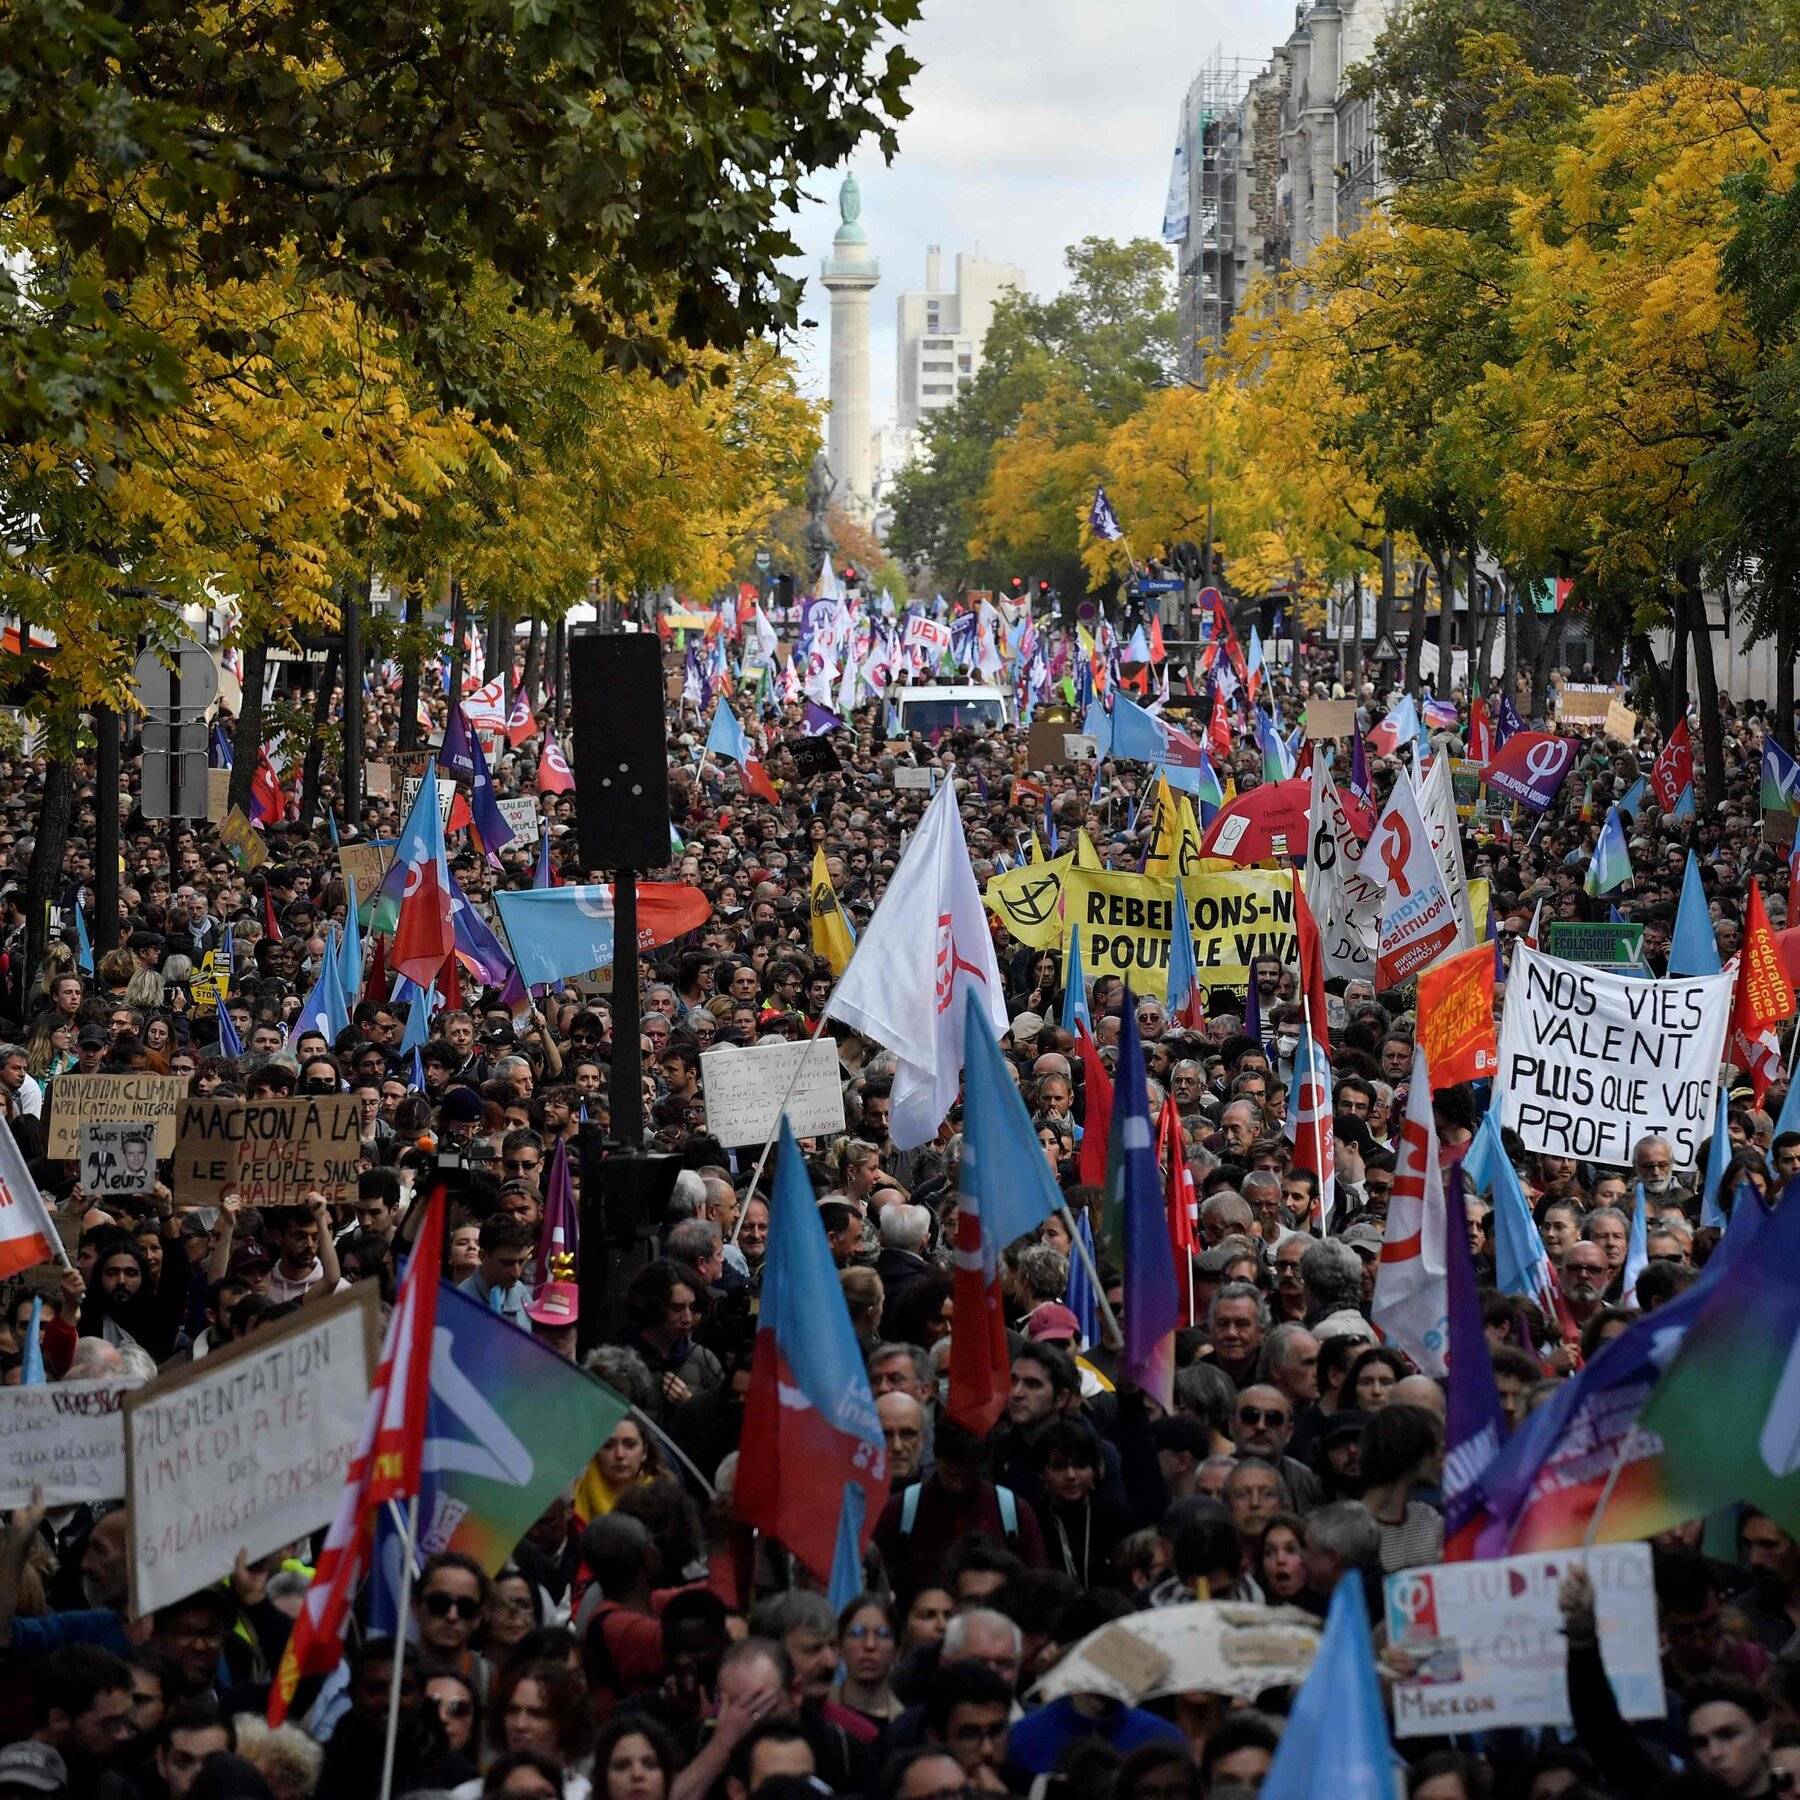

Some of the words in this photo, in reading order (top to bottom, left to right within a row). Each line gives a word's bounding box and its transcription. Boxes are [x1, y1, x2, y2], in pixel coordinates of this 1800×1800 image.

[1087, 890, 1297, 931] REBELONS-N
[1526, 963, 1597, 1016] NOS
[1748, 949, 1777, 1018] services
[1754, 927, 1791, 1014] fédération
[1533, 1010, 1693, 1069] VALENT
[1511, 1054, 1594, 1106] PLUS
[1601, 1076, 1648, 1115] QUE
[1662, 1080, 1711, 1121] VOS
[181, 1103, 297, 1142] MACRON
[331, 1104, 362, 1142] LA
[192, 1160, 227, 1181] LE
[240, 1160, 315, 1183] PEUPLE
[238, 1139, 311, 1165] PLAGE
